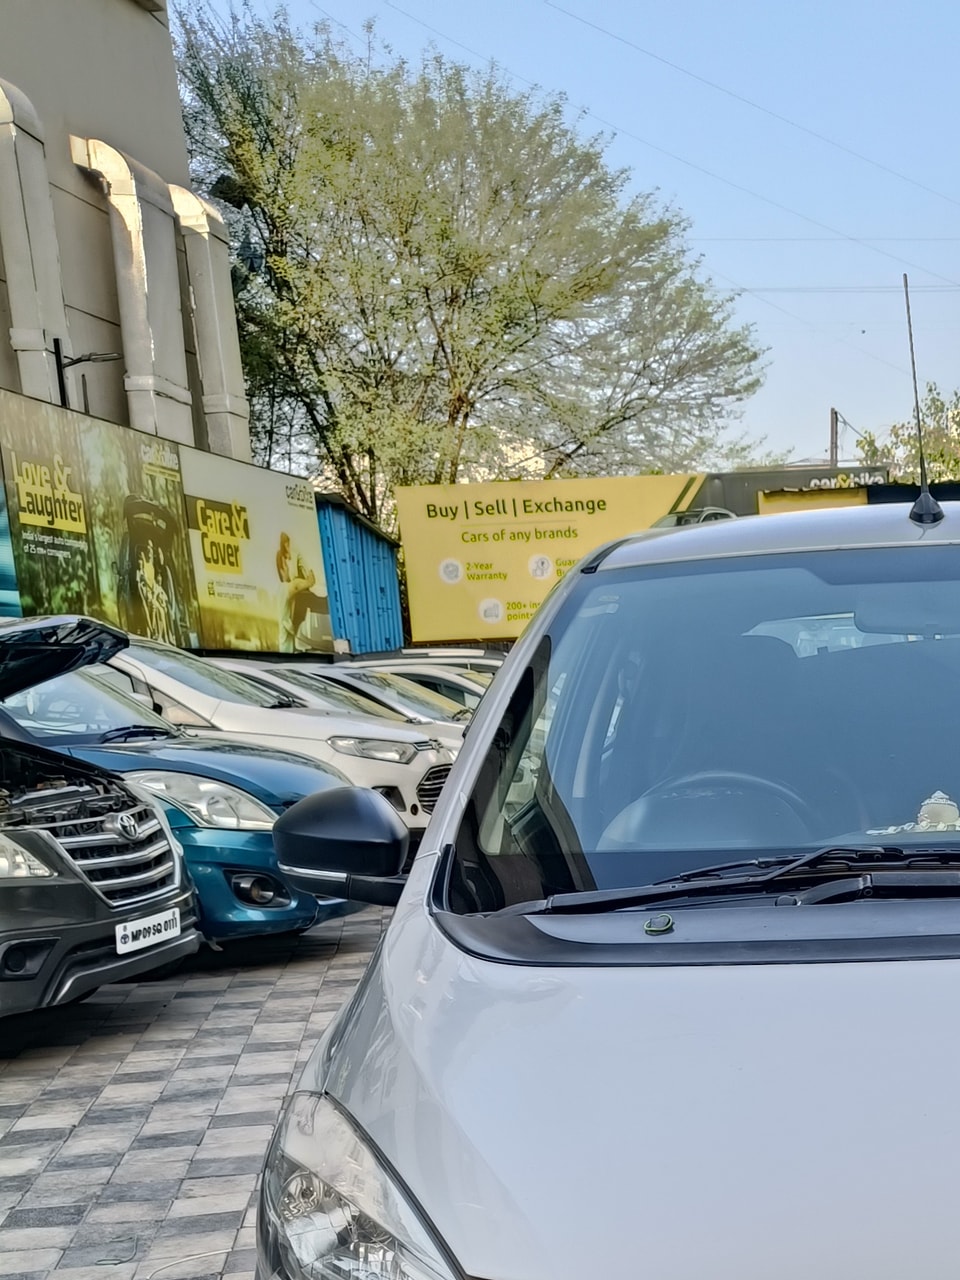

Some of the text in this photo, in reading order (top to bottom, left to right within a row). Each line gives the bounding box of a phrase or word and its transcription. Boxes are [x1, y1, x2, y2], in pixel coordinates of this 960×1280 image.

[11, 451, 51, 488] Love
[17, 482, 82, 526] Laughter
[426, 503, 459, 520] Buy
[474, 499, 507, 516] Sell
[523, 497, 607, 515] Exchange
[196, 500, 231, 537] Care
[461, 526, 579, 543] Cars of any brands
[202, 532, 239, 568] Cover
[466, 562, 493, 571] 2-Year
[467, 572, 508, 581] Warranty
[506, 601, 526, 611] 200+
